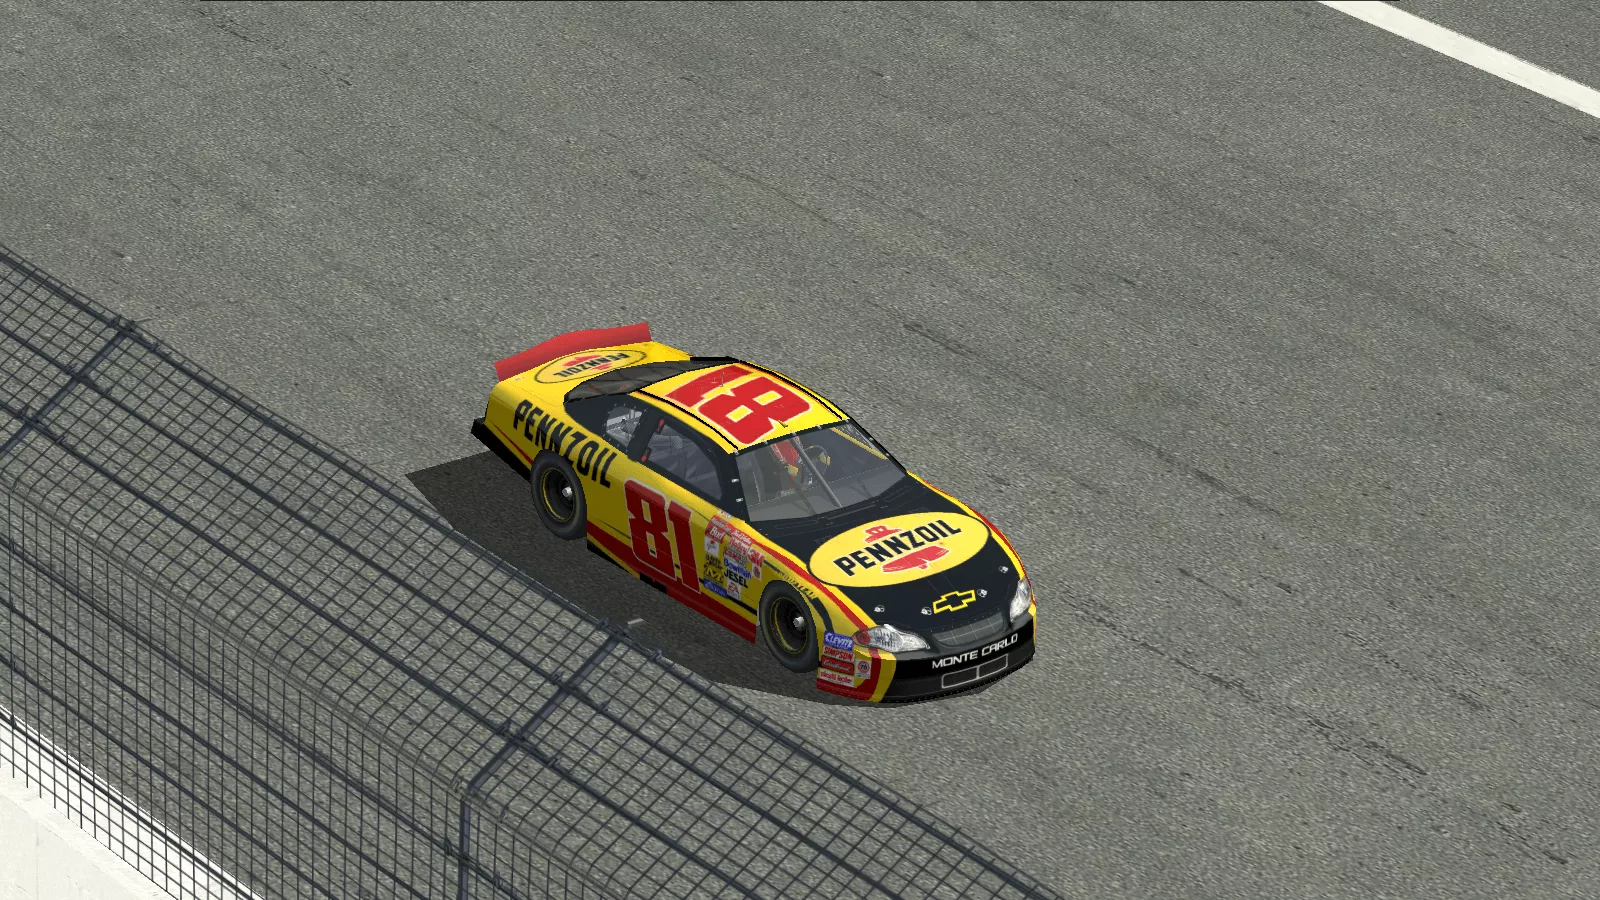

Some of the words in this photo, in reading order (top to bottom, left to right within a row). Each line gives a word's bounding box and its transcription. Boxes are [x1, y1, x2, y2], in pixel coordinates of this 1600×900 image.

[553, 352, 630, 378] PENNZOIL
[666, 365, 812, 445] 81
[513, 399, 617, 489] PENNZOIL
[624, 479, 700, 594] 81
[833, 519, 962, 576] PENNZOIL
[724, 568, 748, 589] JESEL
[932, 650, 978, 669] MONTE
[981, 634, 1018, 657] CARLO
